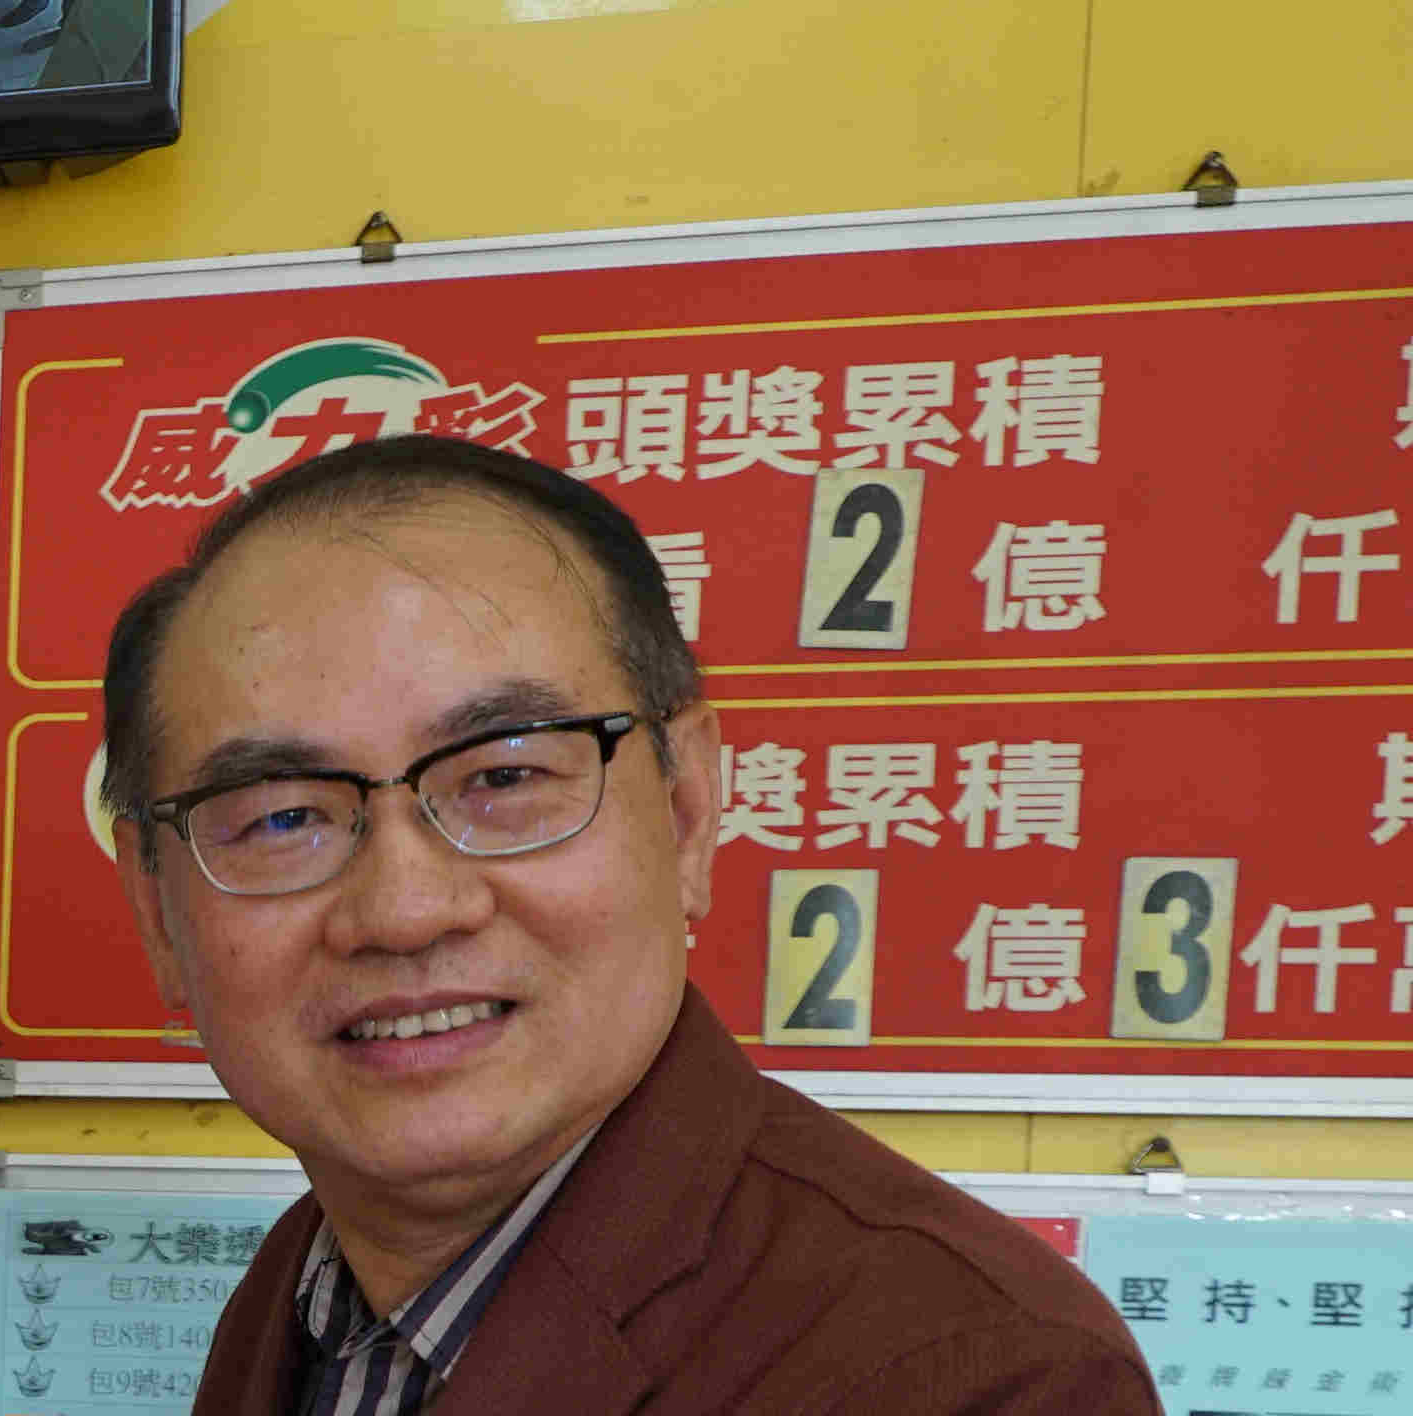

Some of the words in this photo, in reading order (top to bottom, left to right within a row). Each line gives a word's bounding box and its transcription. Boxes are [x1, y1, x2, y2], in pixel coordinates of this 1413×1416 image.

[565, 355, 1104, 482] 頭獎累積
[819, 483, 905, 632] 2
[973, 521, 1107, 632] 億
[782, 885, 863, 1030] 2
[954, 904, 1087, 1012] 億
[1134, 870, 1215, 1024] 3
[1120, 1276, 1413, 1329] 堅持、堅
